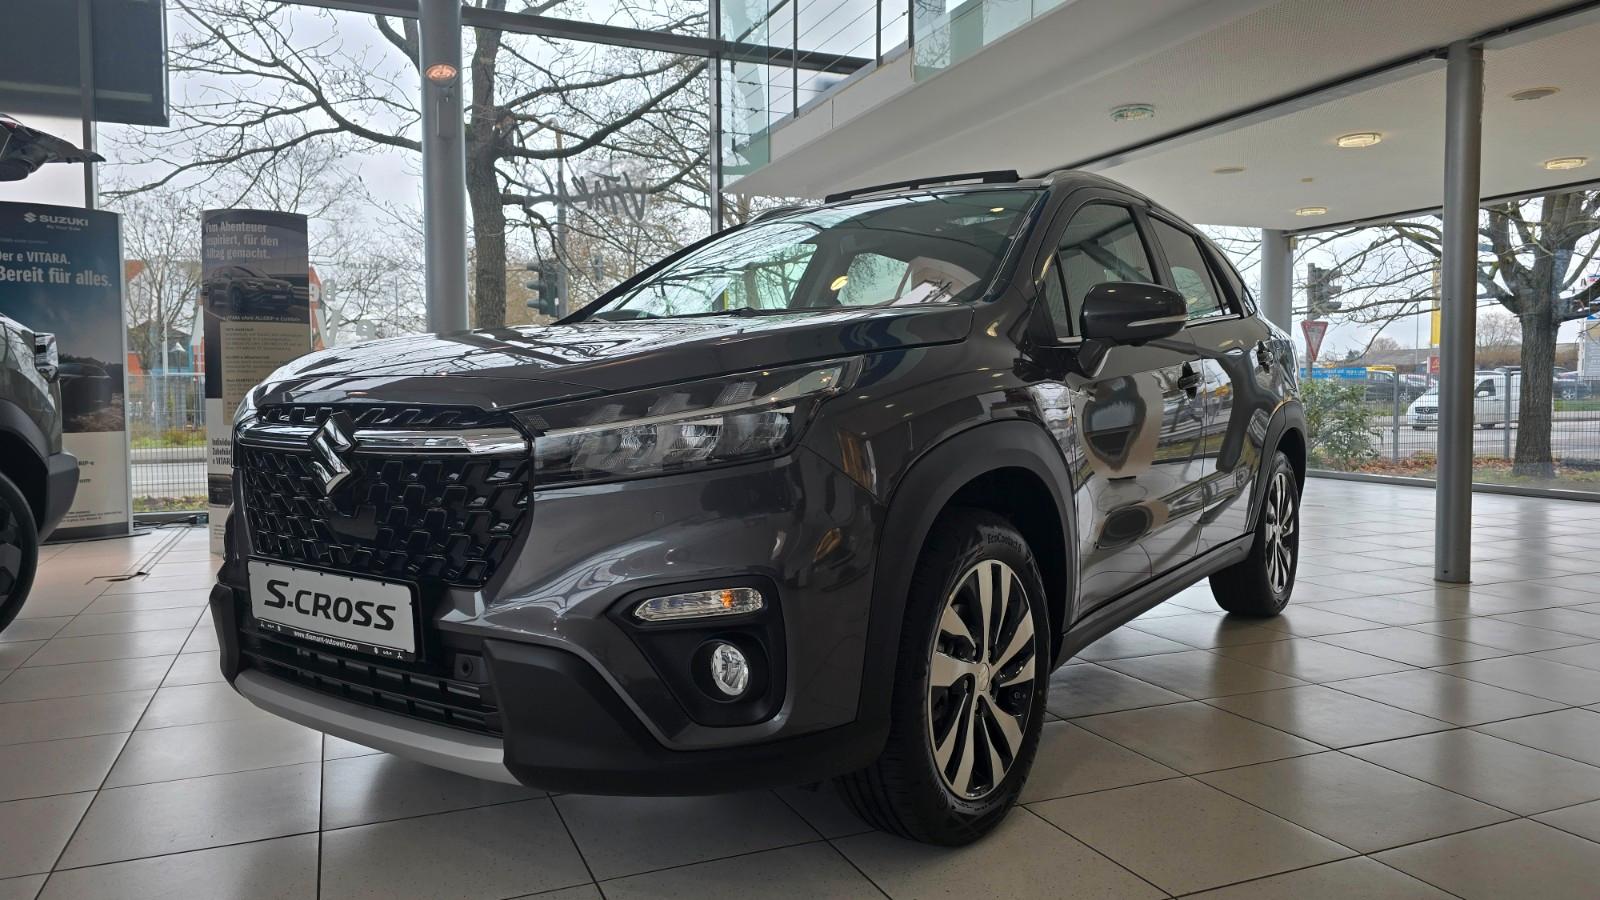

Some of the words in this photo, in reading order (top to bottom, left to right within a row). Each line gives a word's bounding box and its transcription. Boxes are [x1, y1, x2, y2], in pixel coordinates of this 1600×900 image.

[39, 214, 88, 226] SUZUKI
[220, 221, 268, 233] Abenteuer
[243, 234, 259, 246] für
[261, 234, 279, 246] den
[0, 251, 14, 261] er
[16, 252, 24, 262] e
[26, 251, 71, 265] VITARA.
[0, 265, 44, 283] Bereit
[48, 267, 71, 284] für
[75, 269, 112, 287] alles.
